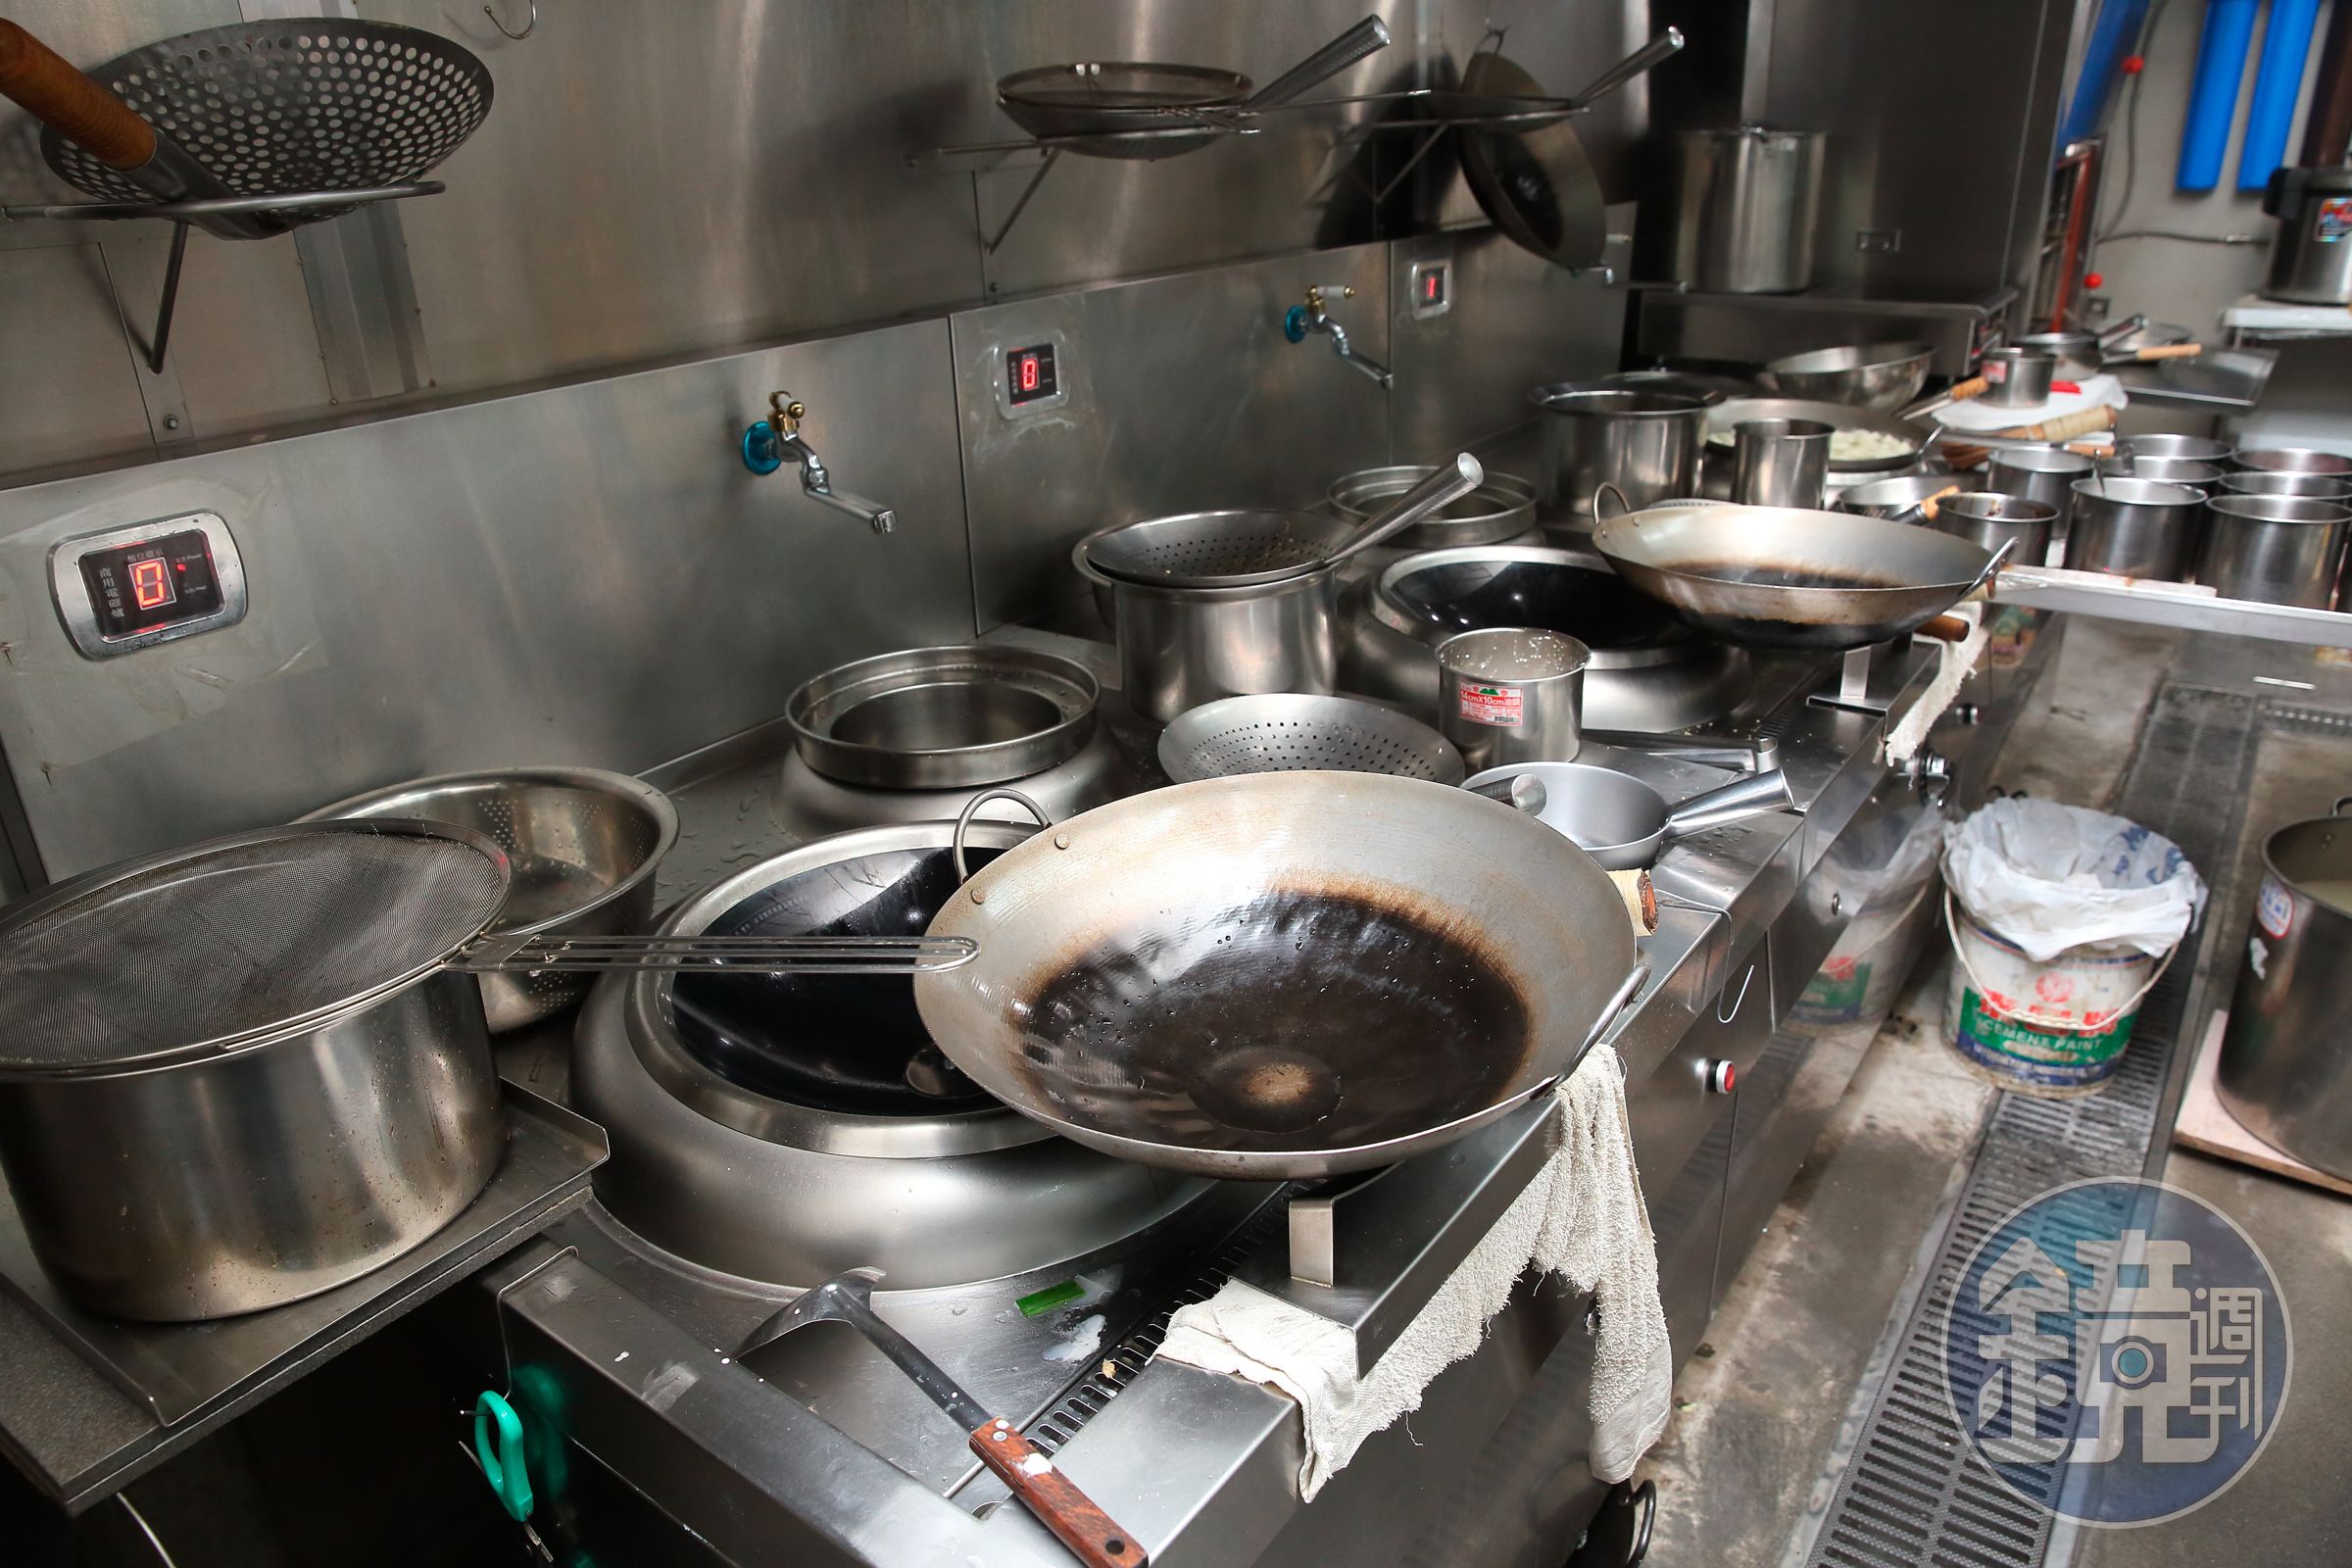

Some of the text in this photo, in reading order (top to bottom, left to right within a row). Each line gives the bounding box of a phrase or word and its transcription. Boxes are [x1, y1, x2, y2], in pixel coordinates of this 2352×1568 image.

[1023, 360, 1036, 390] 0
[135, 561, 166, 607] 0
[2054, 1037, 2103, 1052] PAINT
